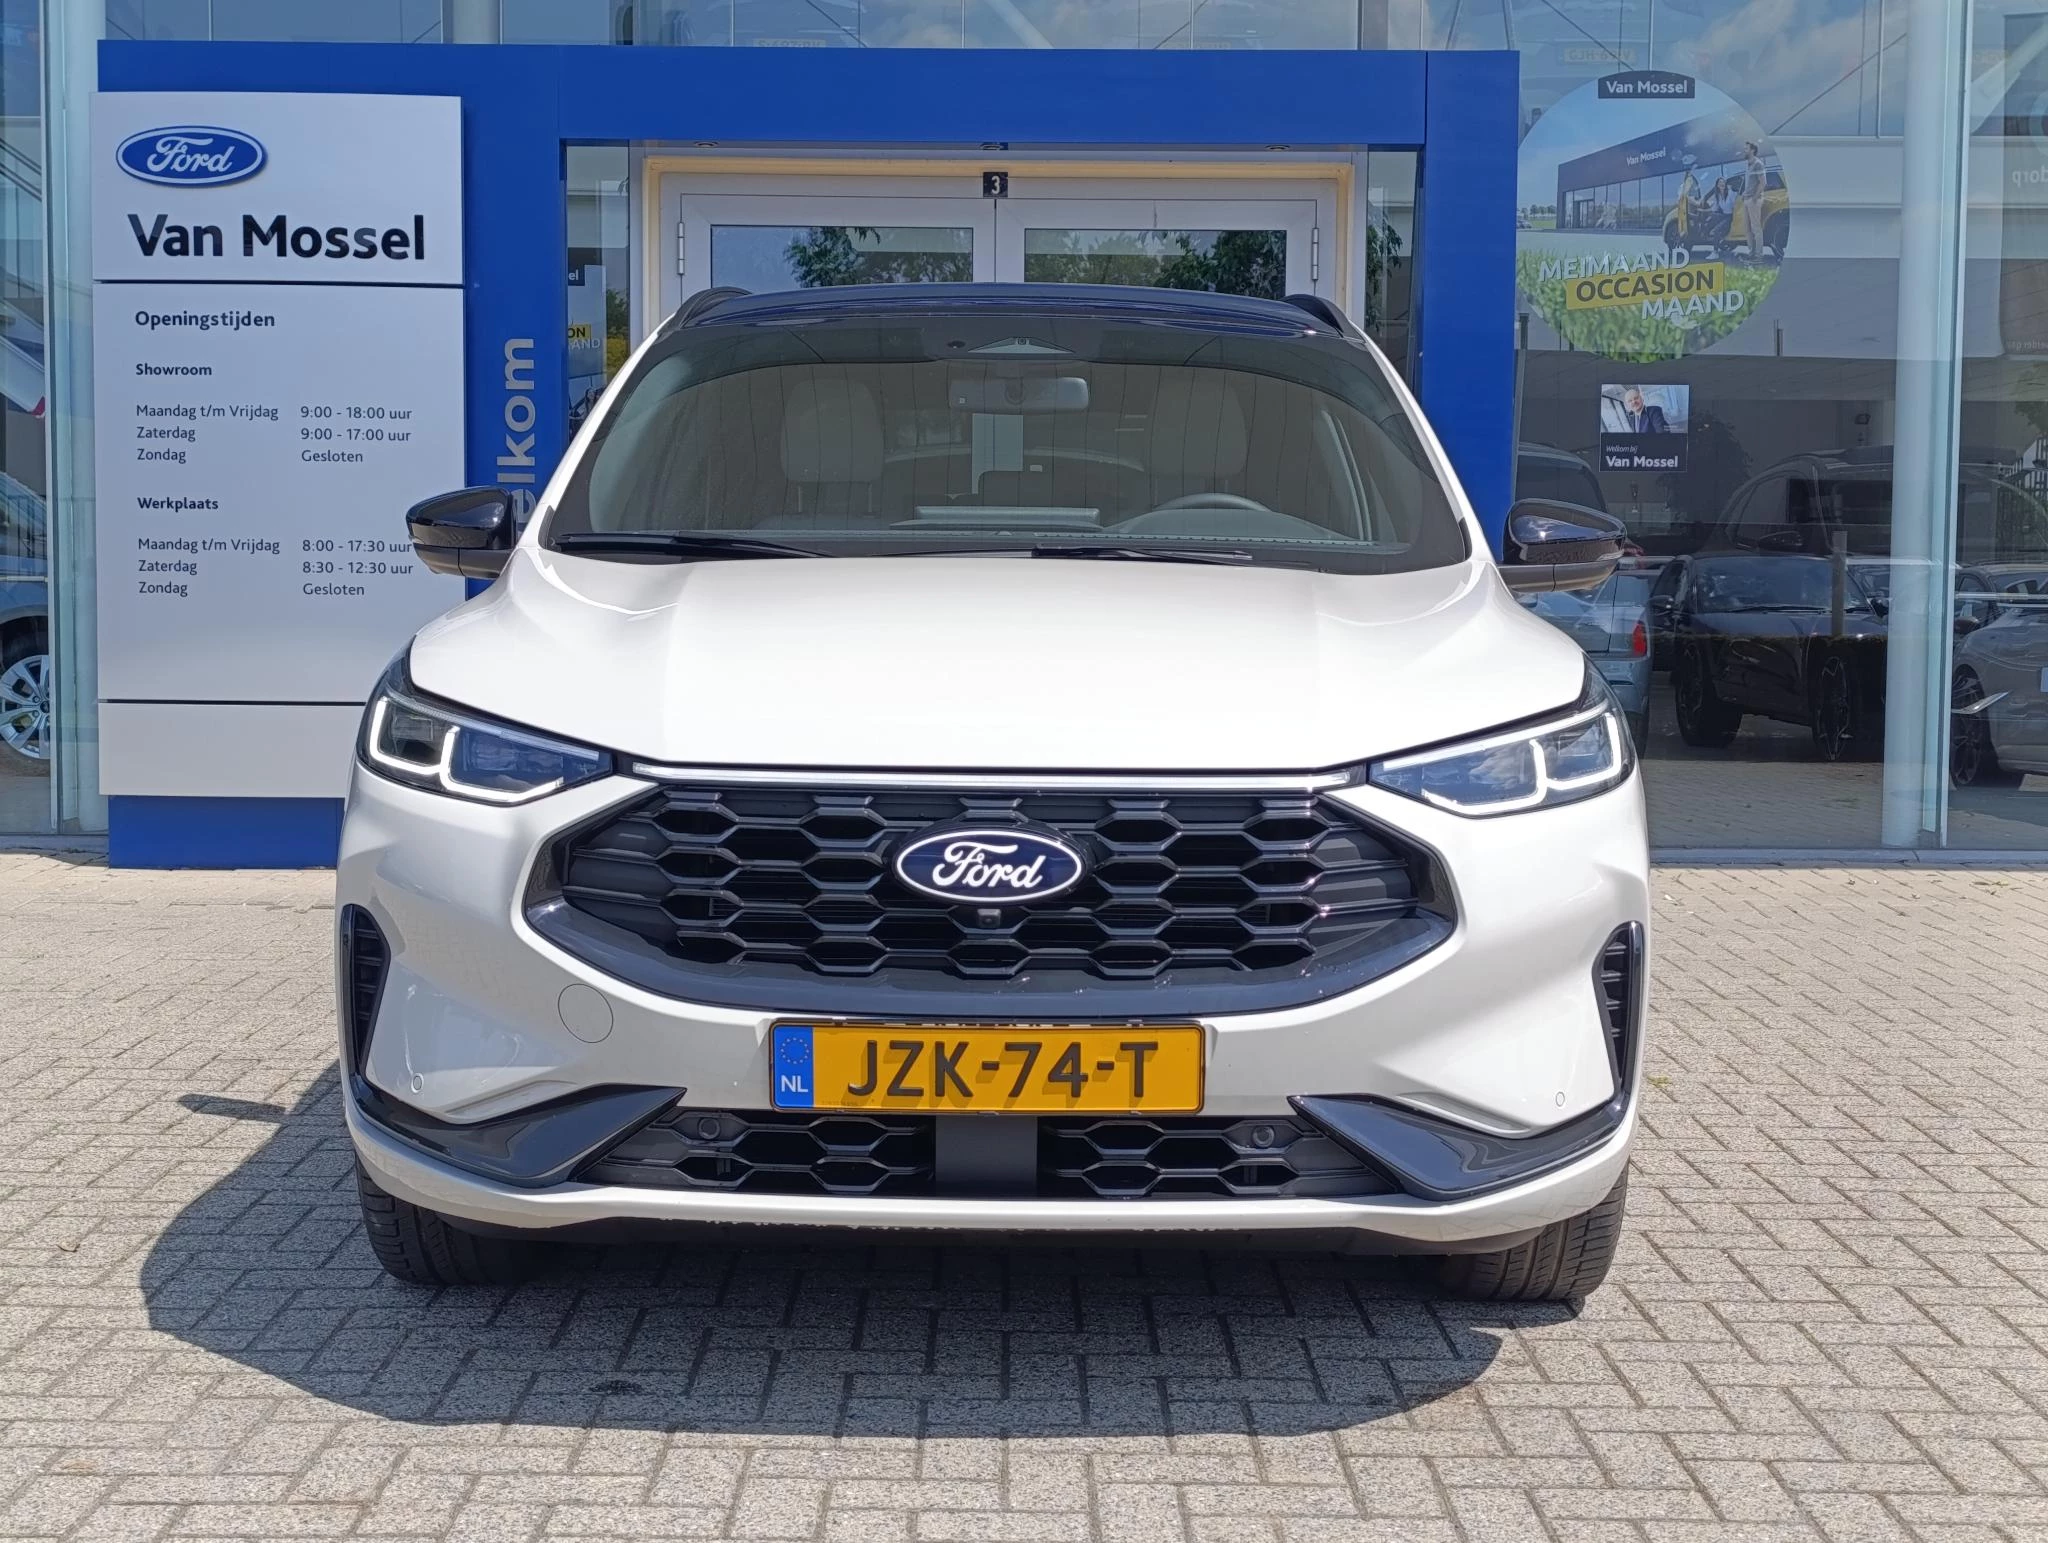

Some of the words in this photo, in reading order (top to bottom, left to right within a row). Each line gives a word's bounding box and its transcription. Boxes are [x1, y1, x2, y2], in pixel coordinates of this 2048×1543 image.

[1606, 80, 1633, 94] Van
[1637, 80, 1688, 94] Mossel
[147, 135, 236, 173] Ford
[1626, 155, 1639, 167] Van
[1640, 146, 1666, 163] Mossel
[991, 175, 1001, 195] 3
[127, 213, 223, 257] Van
[242, 214, 425, 260] Mossel
[1539, 247, 1690, 282] MEIMAAND
[1576, 269, 1714, 302] OCCASION
[1641, 290, 1745, 320] MAAND
[135, 311, 275, 330] Openingstijden
[135, 363, 213, 376] Showroom
[136, 404, 197, 421] Maandag
[200, 404, 226, 418] t/m
[229, 404, 279, 421] Vrijdag
[300, 406, 332, 418] 9:00
[345, 406, 385, 419] 18:00
[389, 410, 413, 419] uur
[136, 426, 196, 442] Zaterdag
[300, 428, 332, 440] 9:00
[347, 428, 384, 441] 17:00
[388, 432, 412, 441] uur
[137, 448, 187, 464] Zondag
[301, 449, 363, 463] Gesloten
[1605, 455, 1630, 468] Van
[1633, 455, 1679, 468] Mossel
[137, 496, 219, 512] Werkplaats
[138, 538, 199, 554] Maandag
[202, 538, 227, 551] t/m
[231, 538, 280, 554] Vrijdag
[302, 540, 334, 552] 8:00
[347, 540, 385, 553] 17:30
[389, 543, 413, 553] uur
[138, 559, 198, 575] Zaterdag
[302, 561, 334, 574] 8:30
[347, 561, 387, 575] 12:30
[390, 565, 414, 575] uur
[138, 581, 188, 597] Zondag
[302, 582, 365, 596] Gesloten
[932, 841, 1047, 888] Ford
[780, 1075, 809, 1093] NL
[847, 1039, 1159, 1099] JZK-74-T
